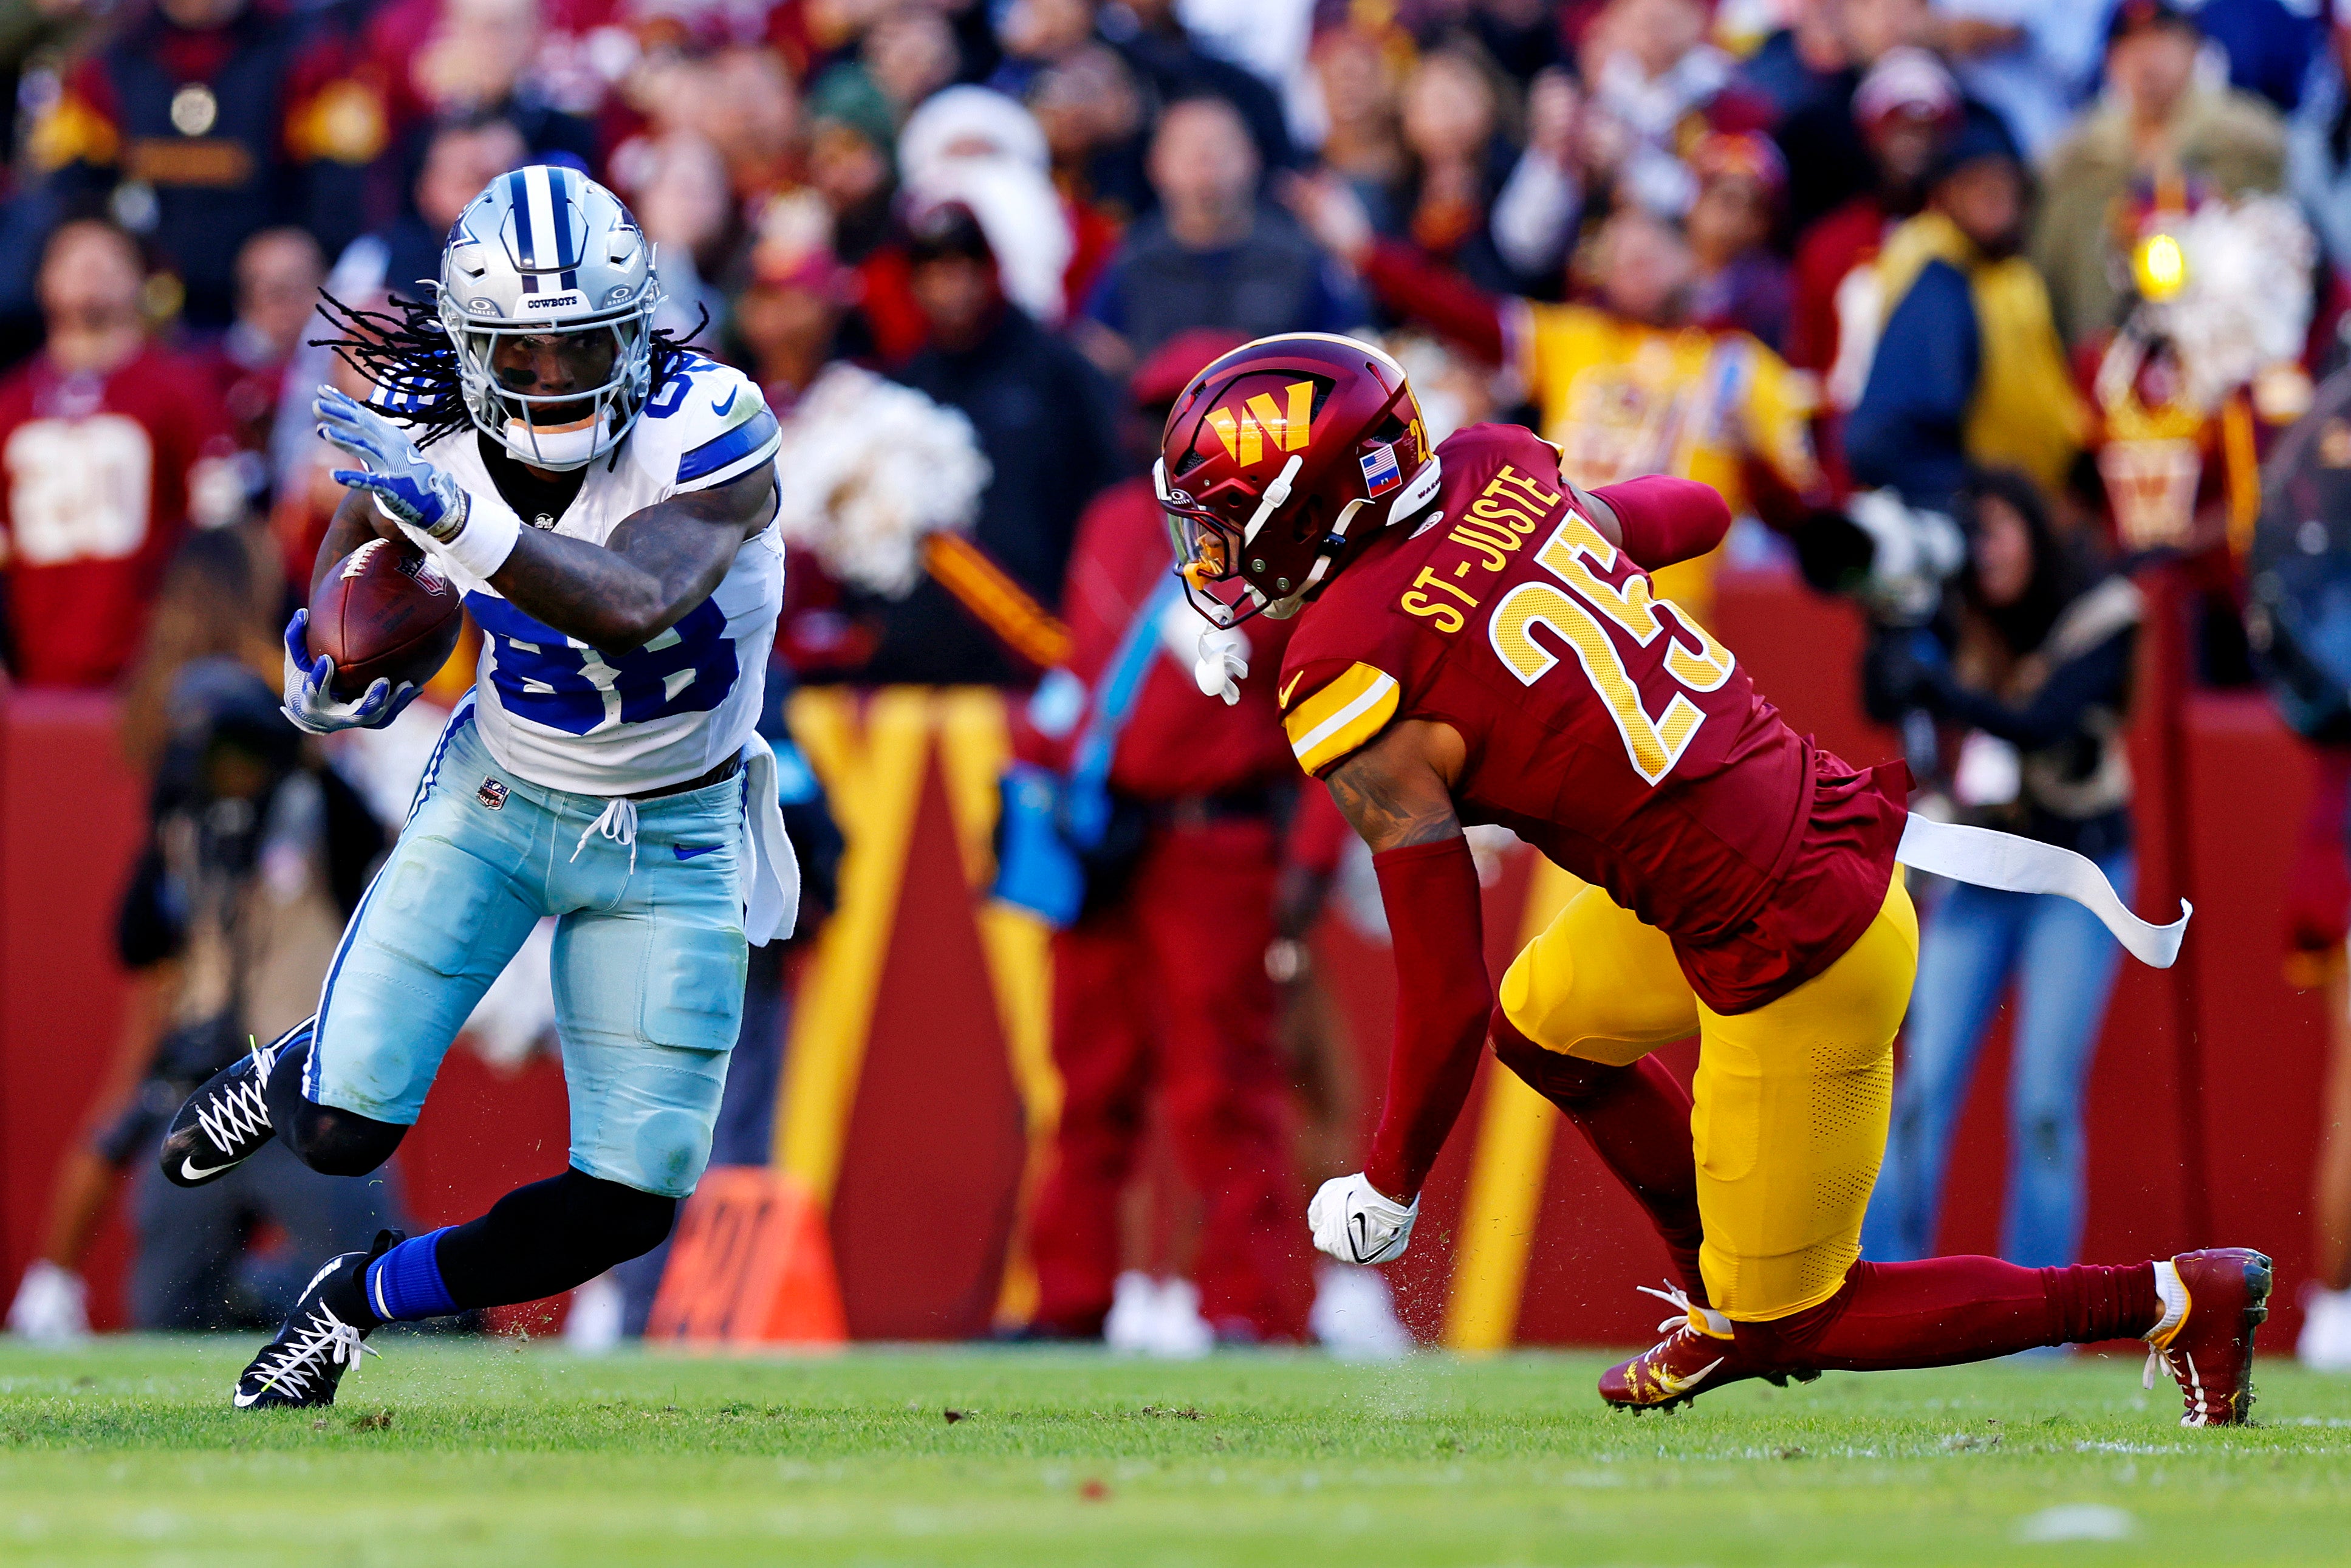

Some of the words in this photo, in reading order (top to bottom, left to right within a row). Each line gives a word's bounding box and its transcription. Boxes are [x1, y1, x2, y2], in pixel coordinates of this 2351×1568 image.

[528, 296, 578, 309] COWBOYS
[607, 295, 632, 306] OAKLEY
[1204, 380, 1313, 468] W
[1401, 465, 1561, 633] ST-JUSTE
[464, 589, 740, 736] 88
[1488, 508, 1736, 787] 25
